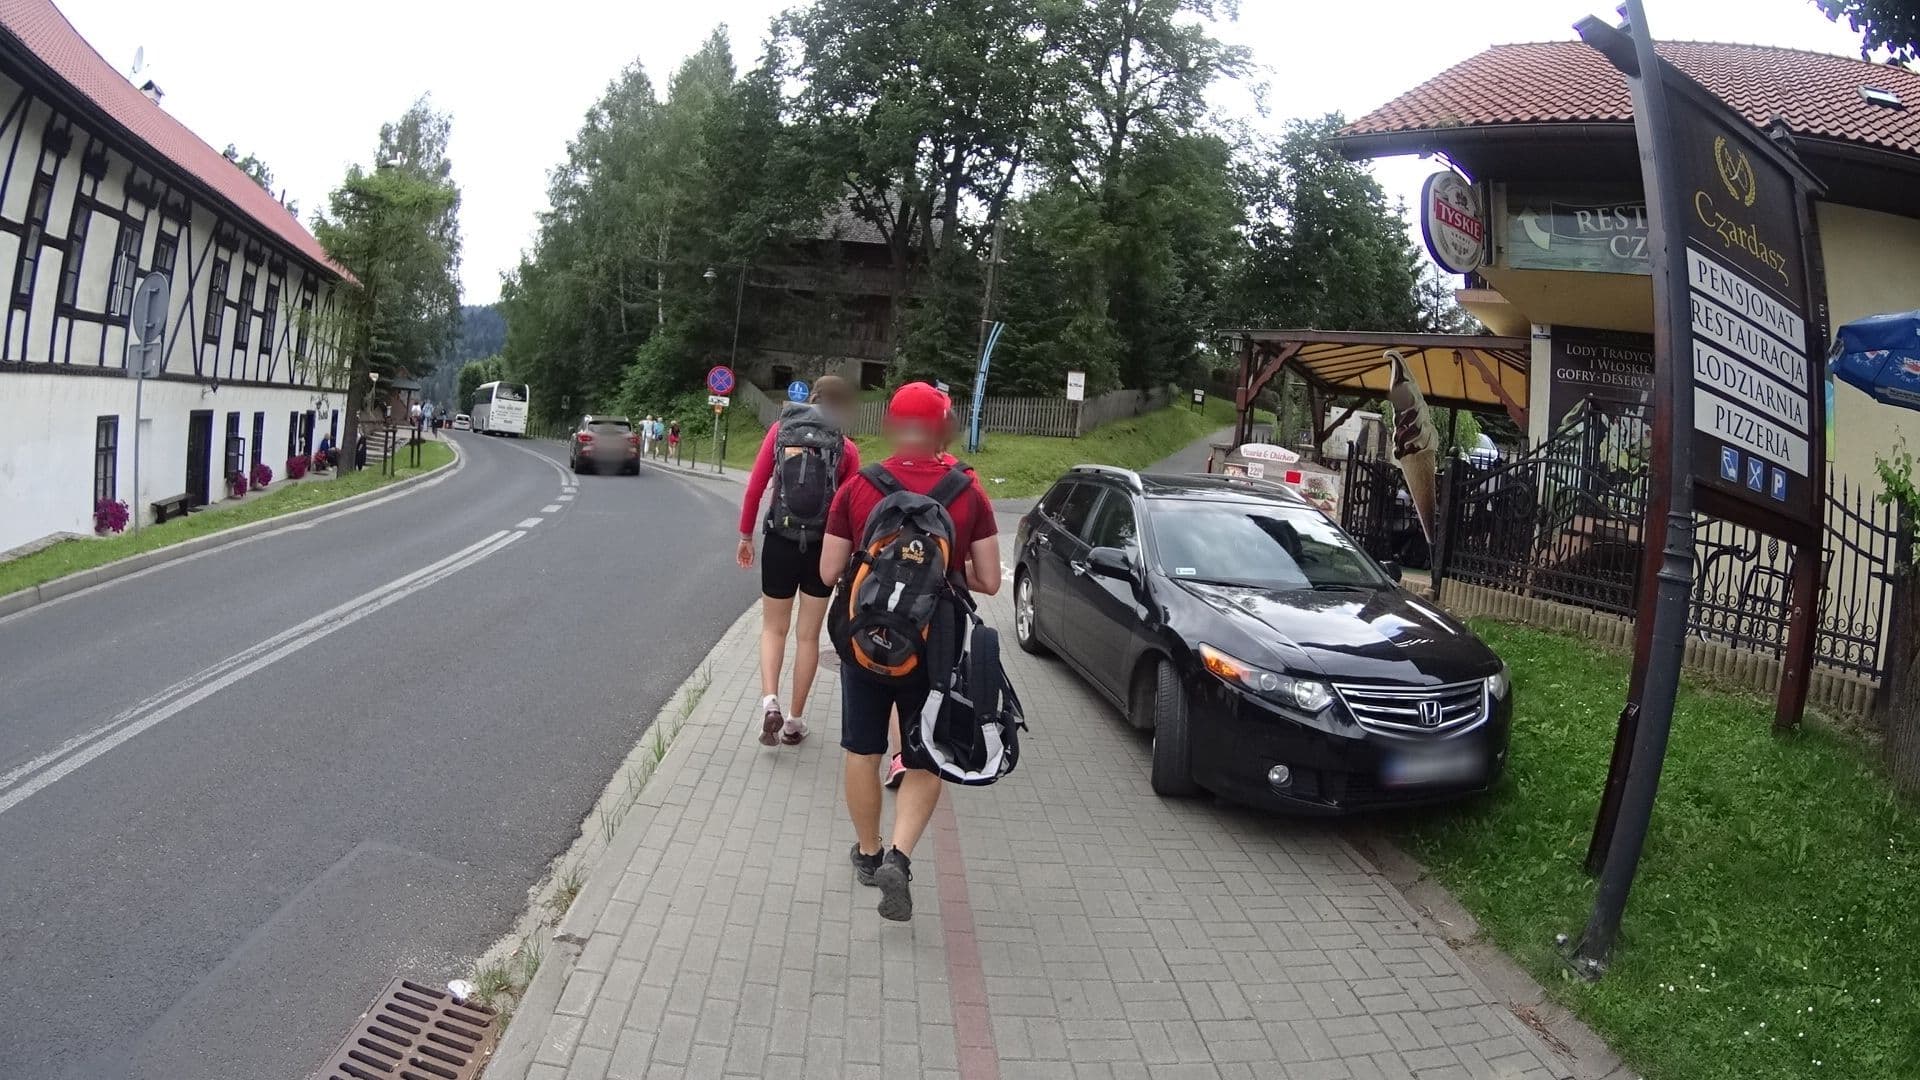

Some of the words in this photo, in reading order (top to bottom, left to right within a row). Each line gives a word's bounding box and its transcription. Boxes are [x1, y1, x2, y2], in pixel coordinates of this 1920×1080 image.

[1438, 202, 1480, 239] TYSKIE
[1695, 190, 1789, 287] Czardasz
[1610, 235, 1649, 259] CZ
[1697, 259, 1795, 339] PENSJONAT
[1566, 343, 1598, 357] LODY
[1691, 299, 1805, 385] RESTAURACJA
[1556, 367, 1596, 382] GOFRY
[1602, 372, 1645, 387] DESERY
[1696, 348, 1803, 426] LODZIARNIA
[1715, 405, 1791, 462] PIZZERIA
[1774, 473, 1783, 494] P
